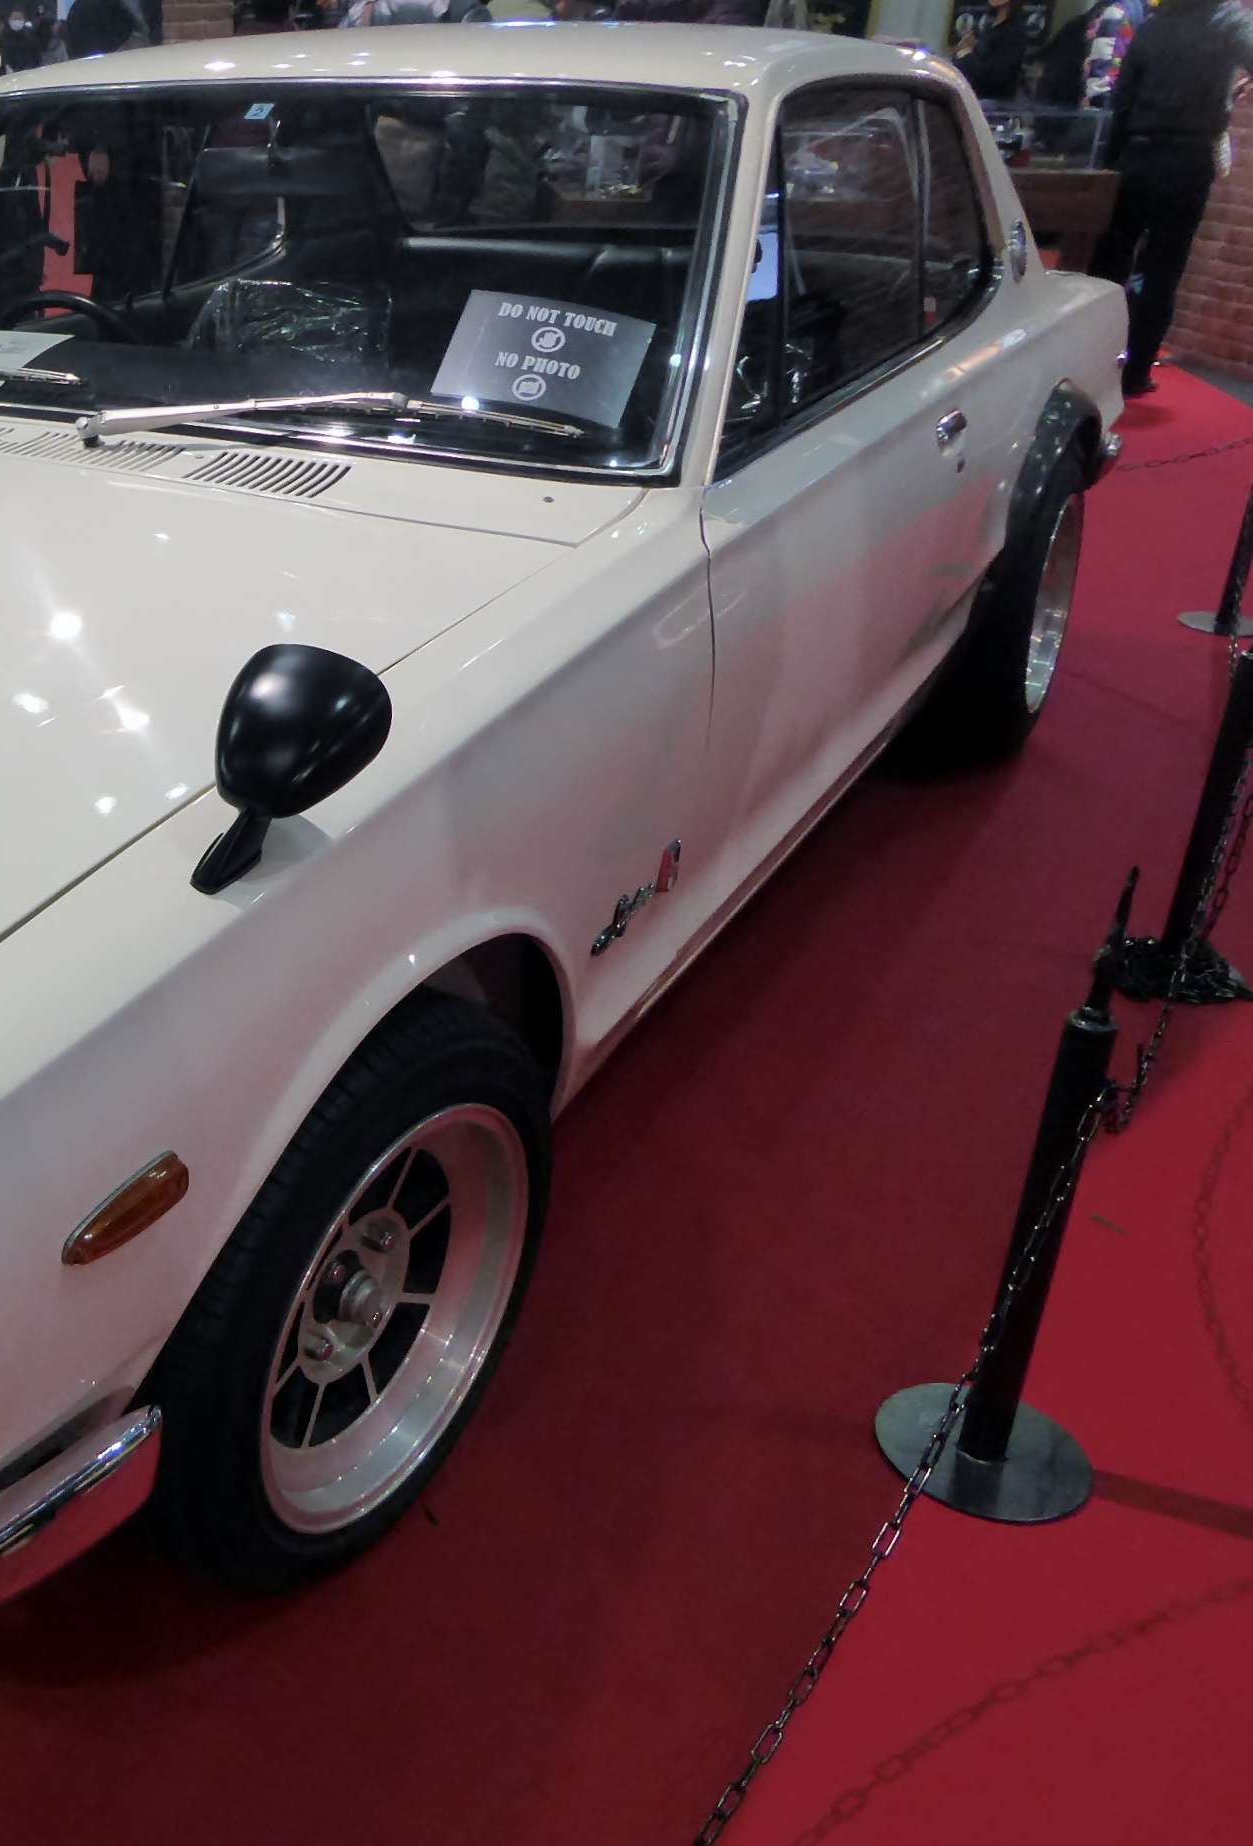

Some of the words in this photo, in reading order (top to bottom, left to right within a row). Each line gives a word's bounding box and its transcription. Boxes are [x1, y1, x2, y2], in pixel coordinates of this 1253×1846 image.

[498, 302, 523, 318] DO
[525, 306, 561, 324] NOT
[563, 312, 618, 337] TOUCH
[494, 351, 519, 368] NO
[521, 355, 581, 380] PHOTO
